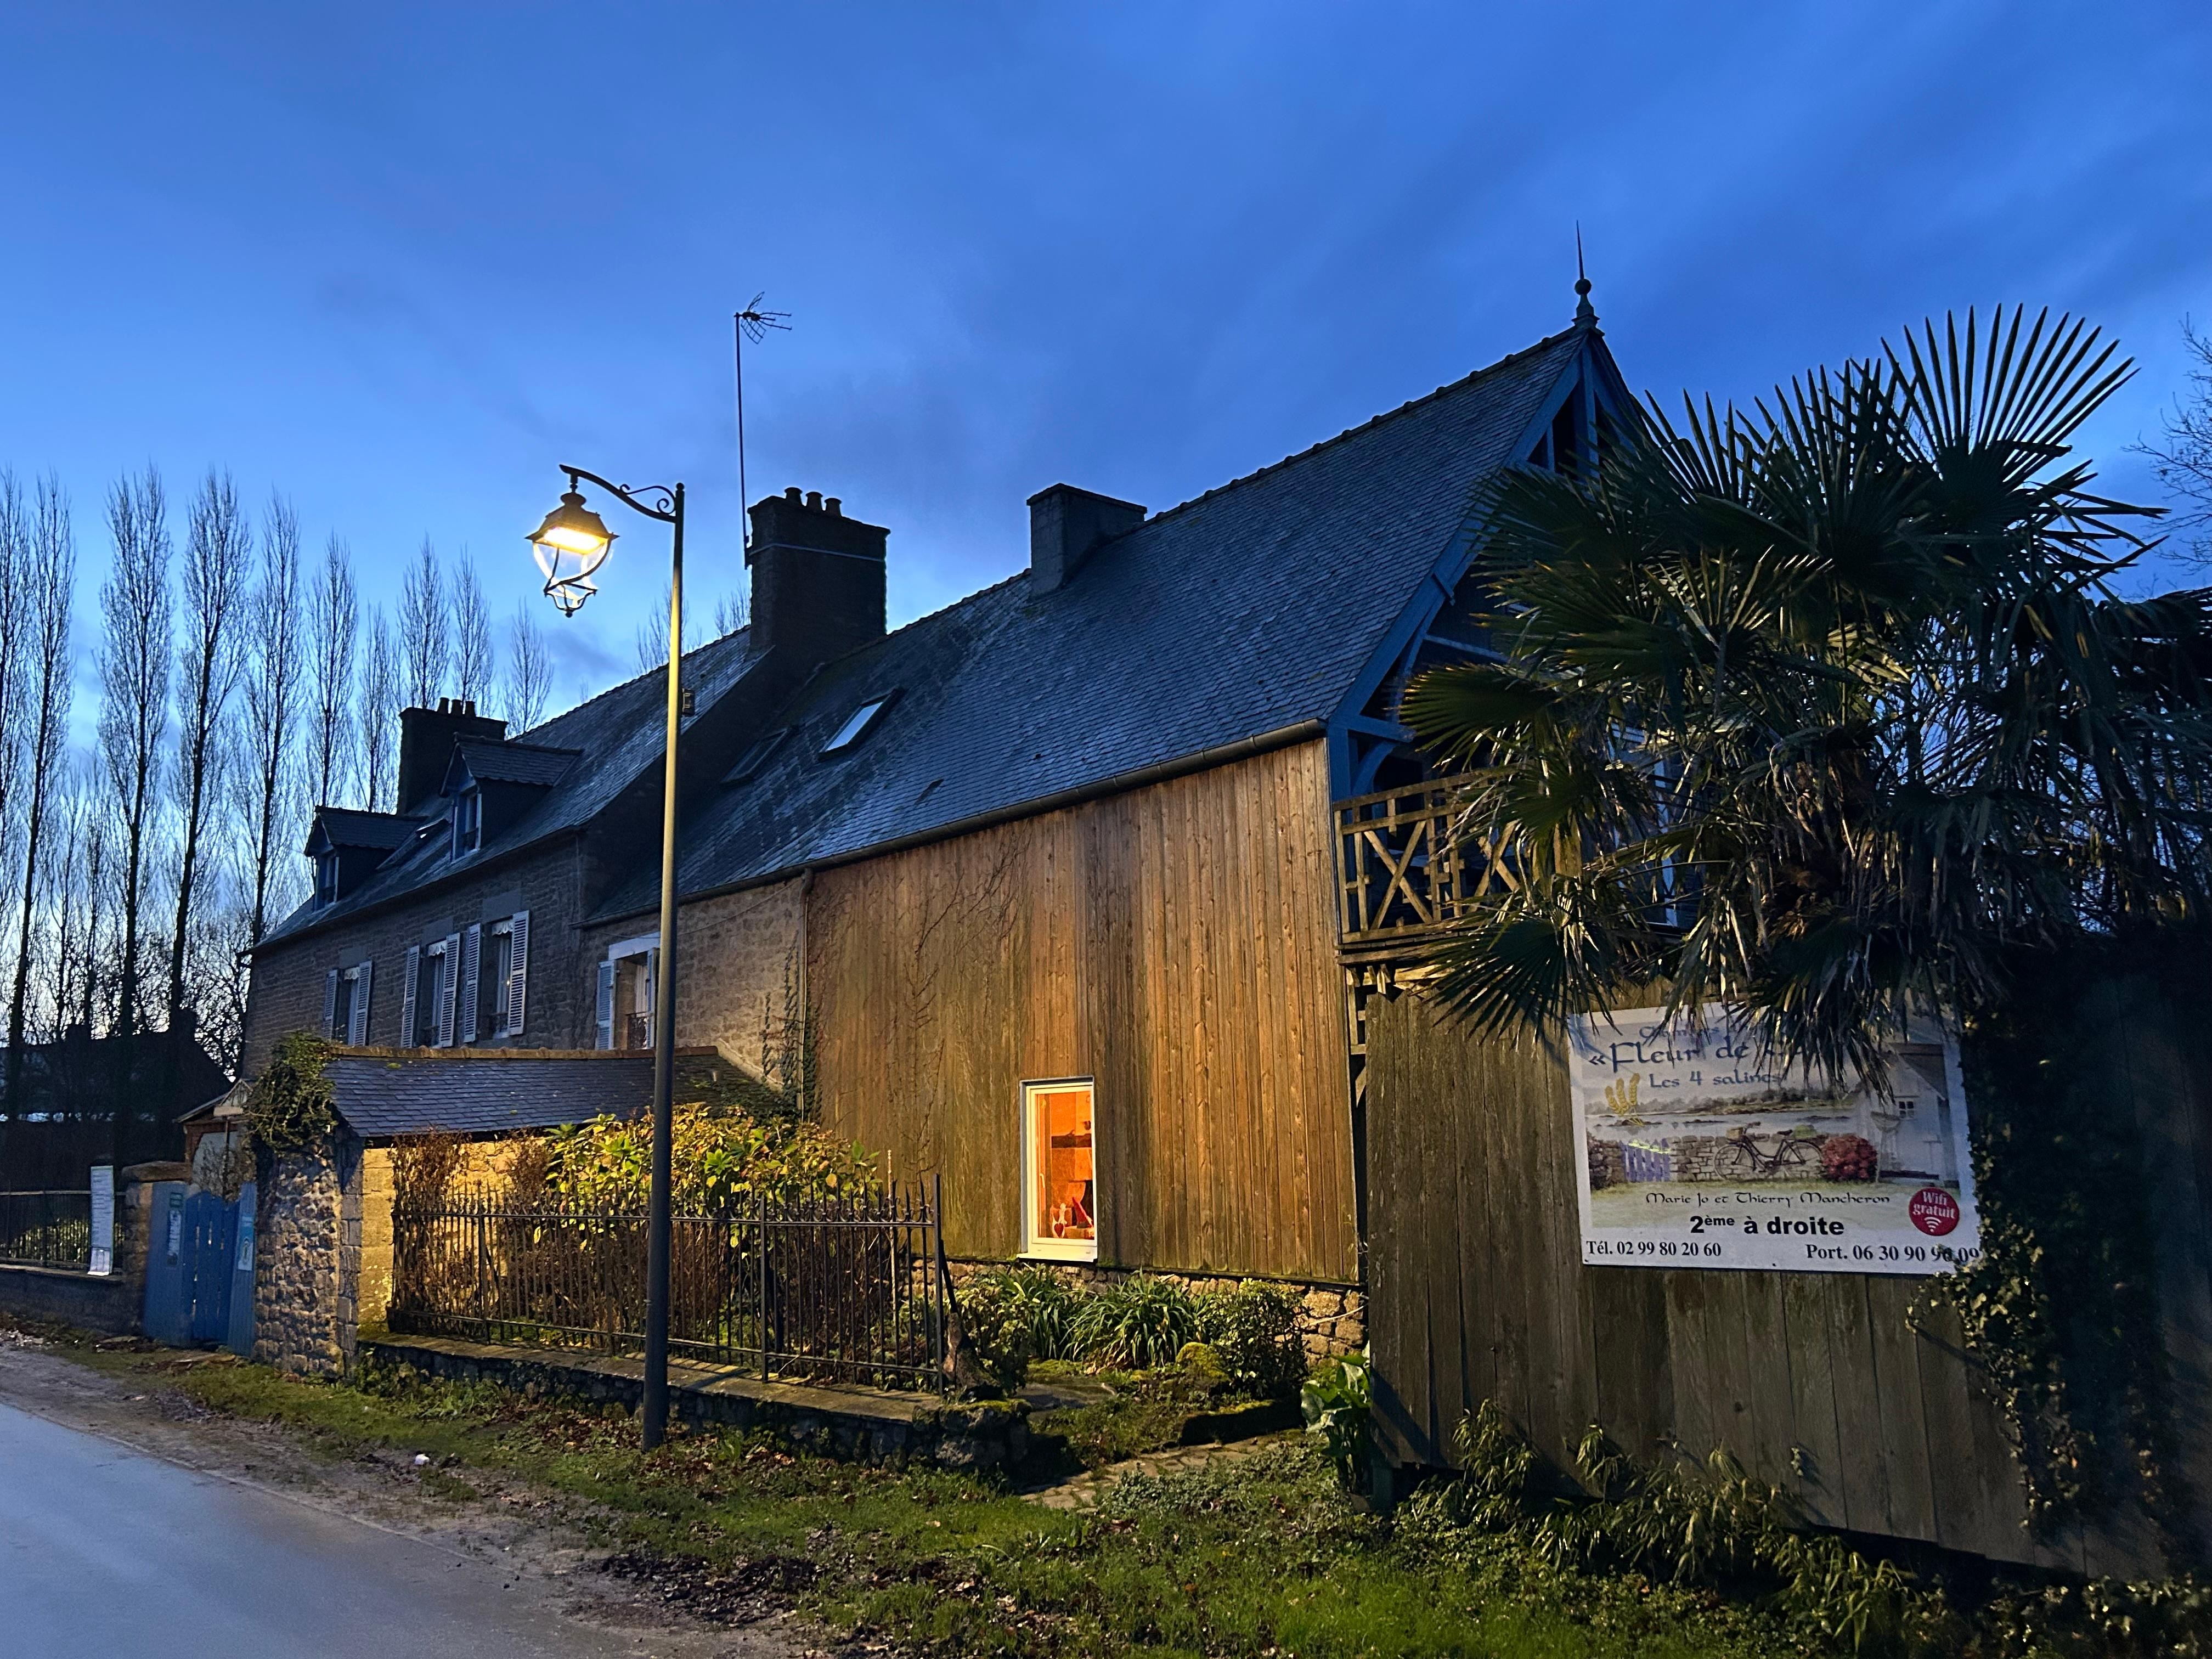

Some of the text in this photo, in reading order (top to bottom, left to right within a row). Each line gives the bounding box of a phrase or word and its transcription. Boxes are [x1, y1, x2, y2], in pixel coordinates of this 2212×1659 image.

[1716, 1035, 1749, 1058] de
[1649, 1073, 1680, 1087] Les
[1690, 1071, 1702, 1086] 4
[1646, 1193, 1691, 1203] Marie
[1697, 1192, 1709, 1207] Jo
[1734, 1192, 1794, 1207] Thierry
[1800, 1192, 1890, 1203] Mancheron
[1922, 1191, 1947, 1206] Wifi
[1912, 1203, 1955, 1218] gratuit
[1690, 1215, 1844, 1235] 2ème à droite
[1586, 1240, 1722, 1256] Tél. 02 99 80 20 60
[1805, 1244, 1848, 1259] Port.
[1853, 1245, 1873, 1260] 06
[1878, 1245, 1899, 1261] 30
[1904, 1246, 1925, 1261] 90
